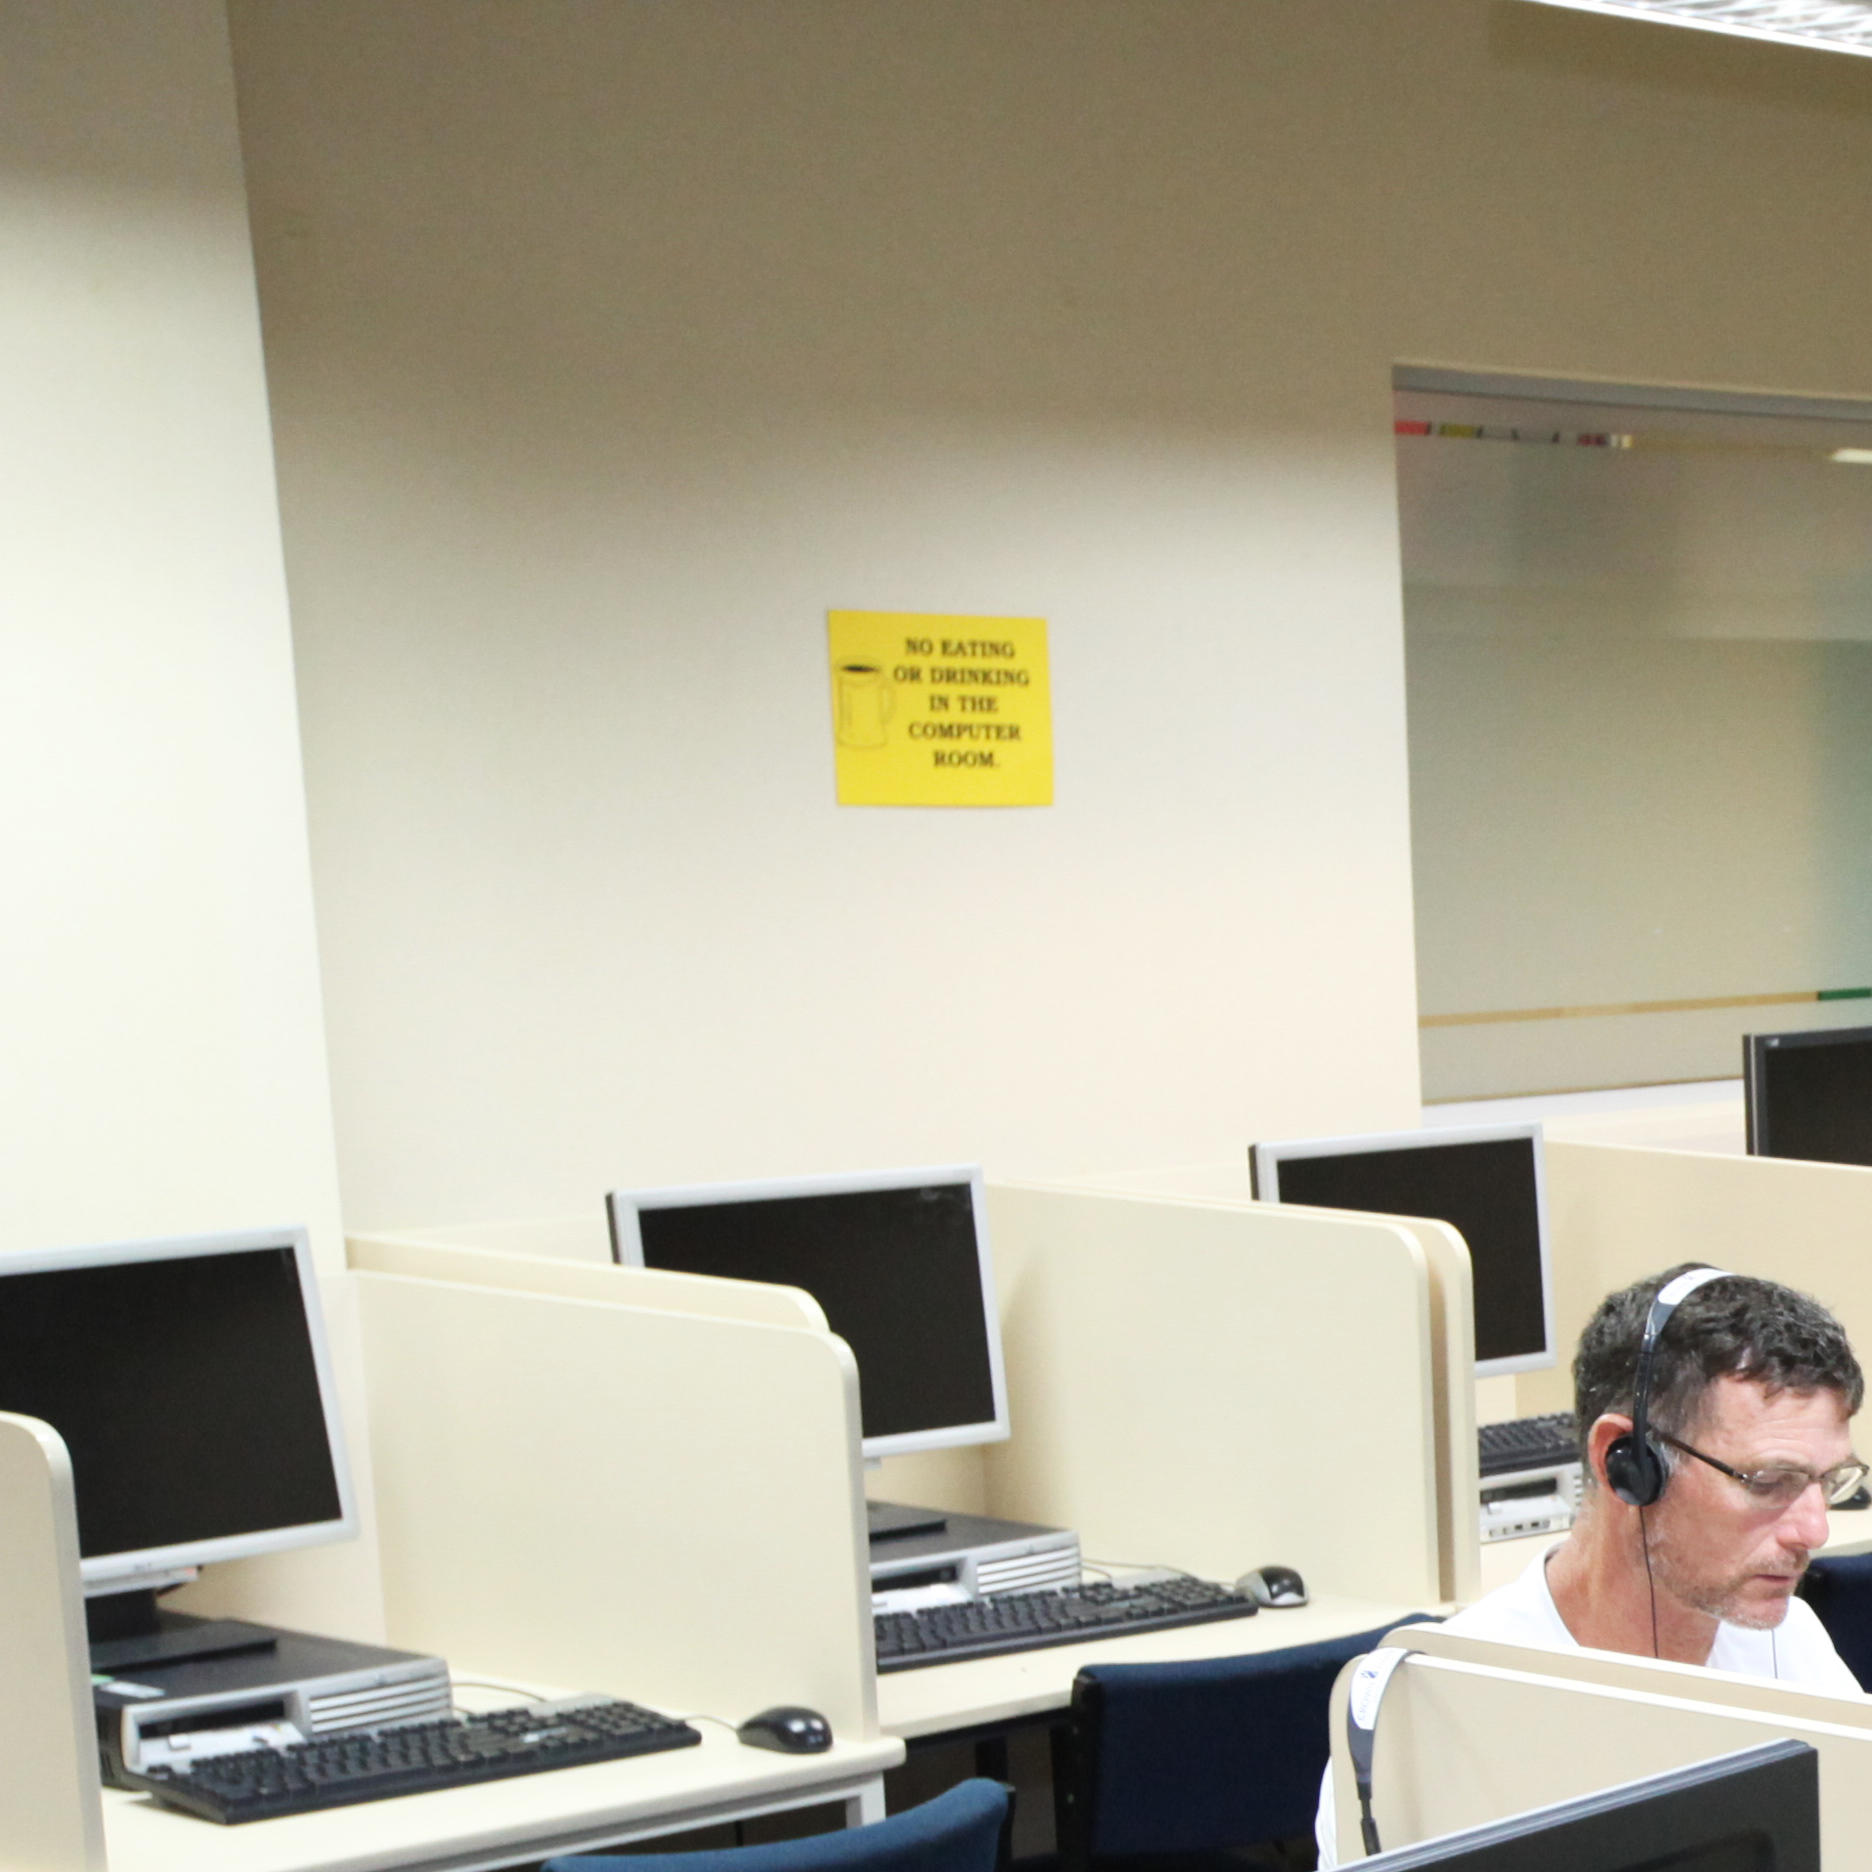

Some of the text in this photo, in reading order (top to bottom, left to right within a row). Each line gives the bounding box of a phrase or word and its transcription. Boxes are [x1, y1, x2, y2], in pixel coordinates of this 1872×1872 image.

[905, 637, 1015, 659] NO EATING
[893, 665, 1030, 687] OR DRINKING
[929, 695, 999, 713] IN THE
[908, 721, 1021, 741] COMPUTER
